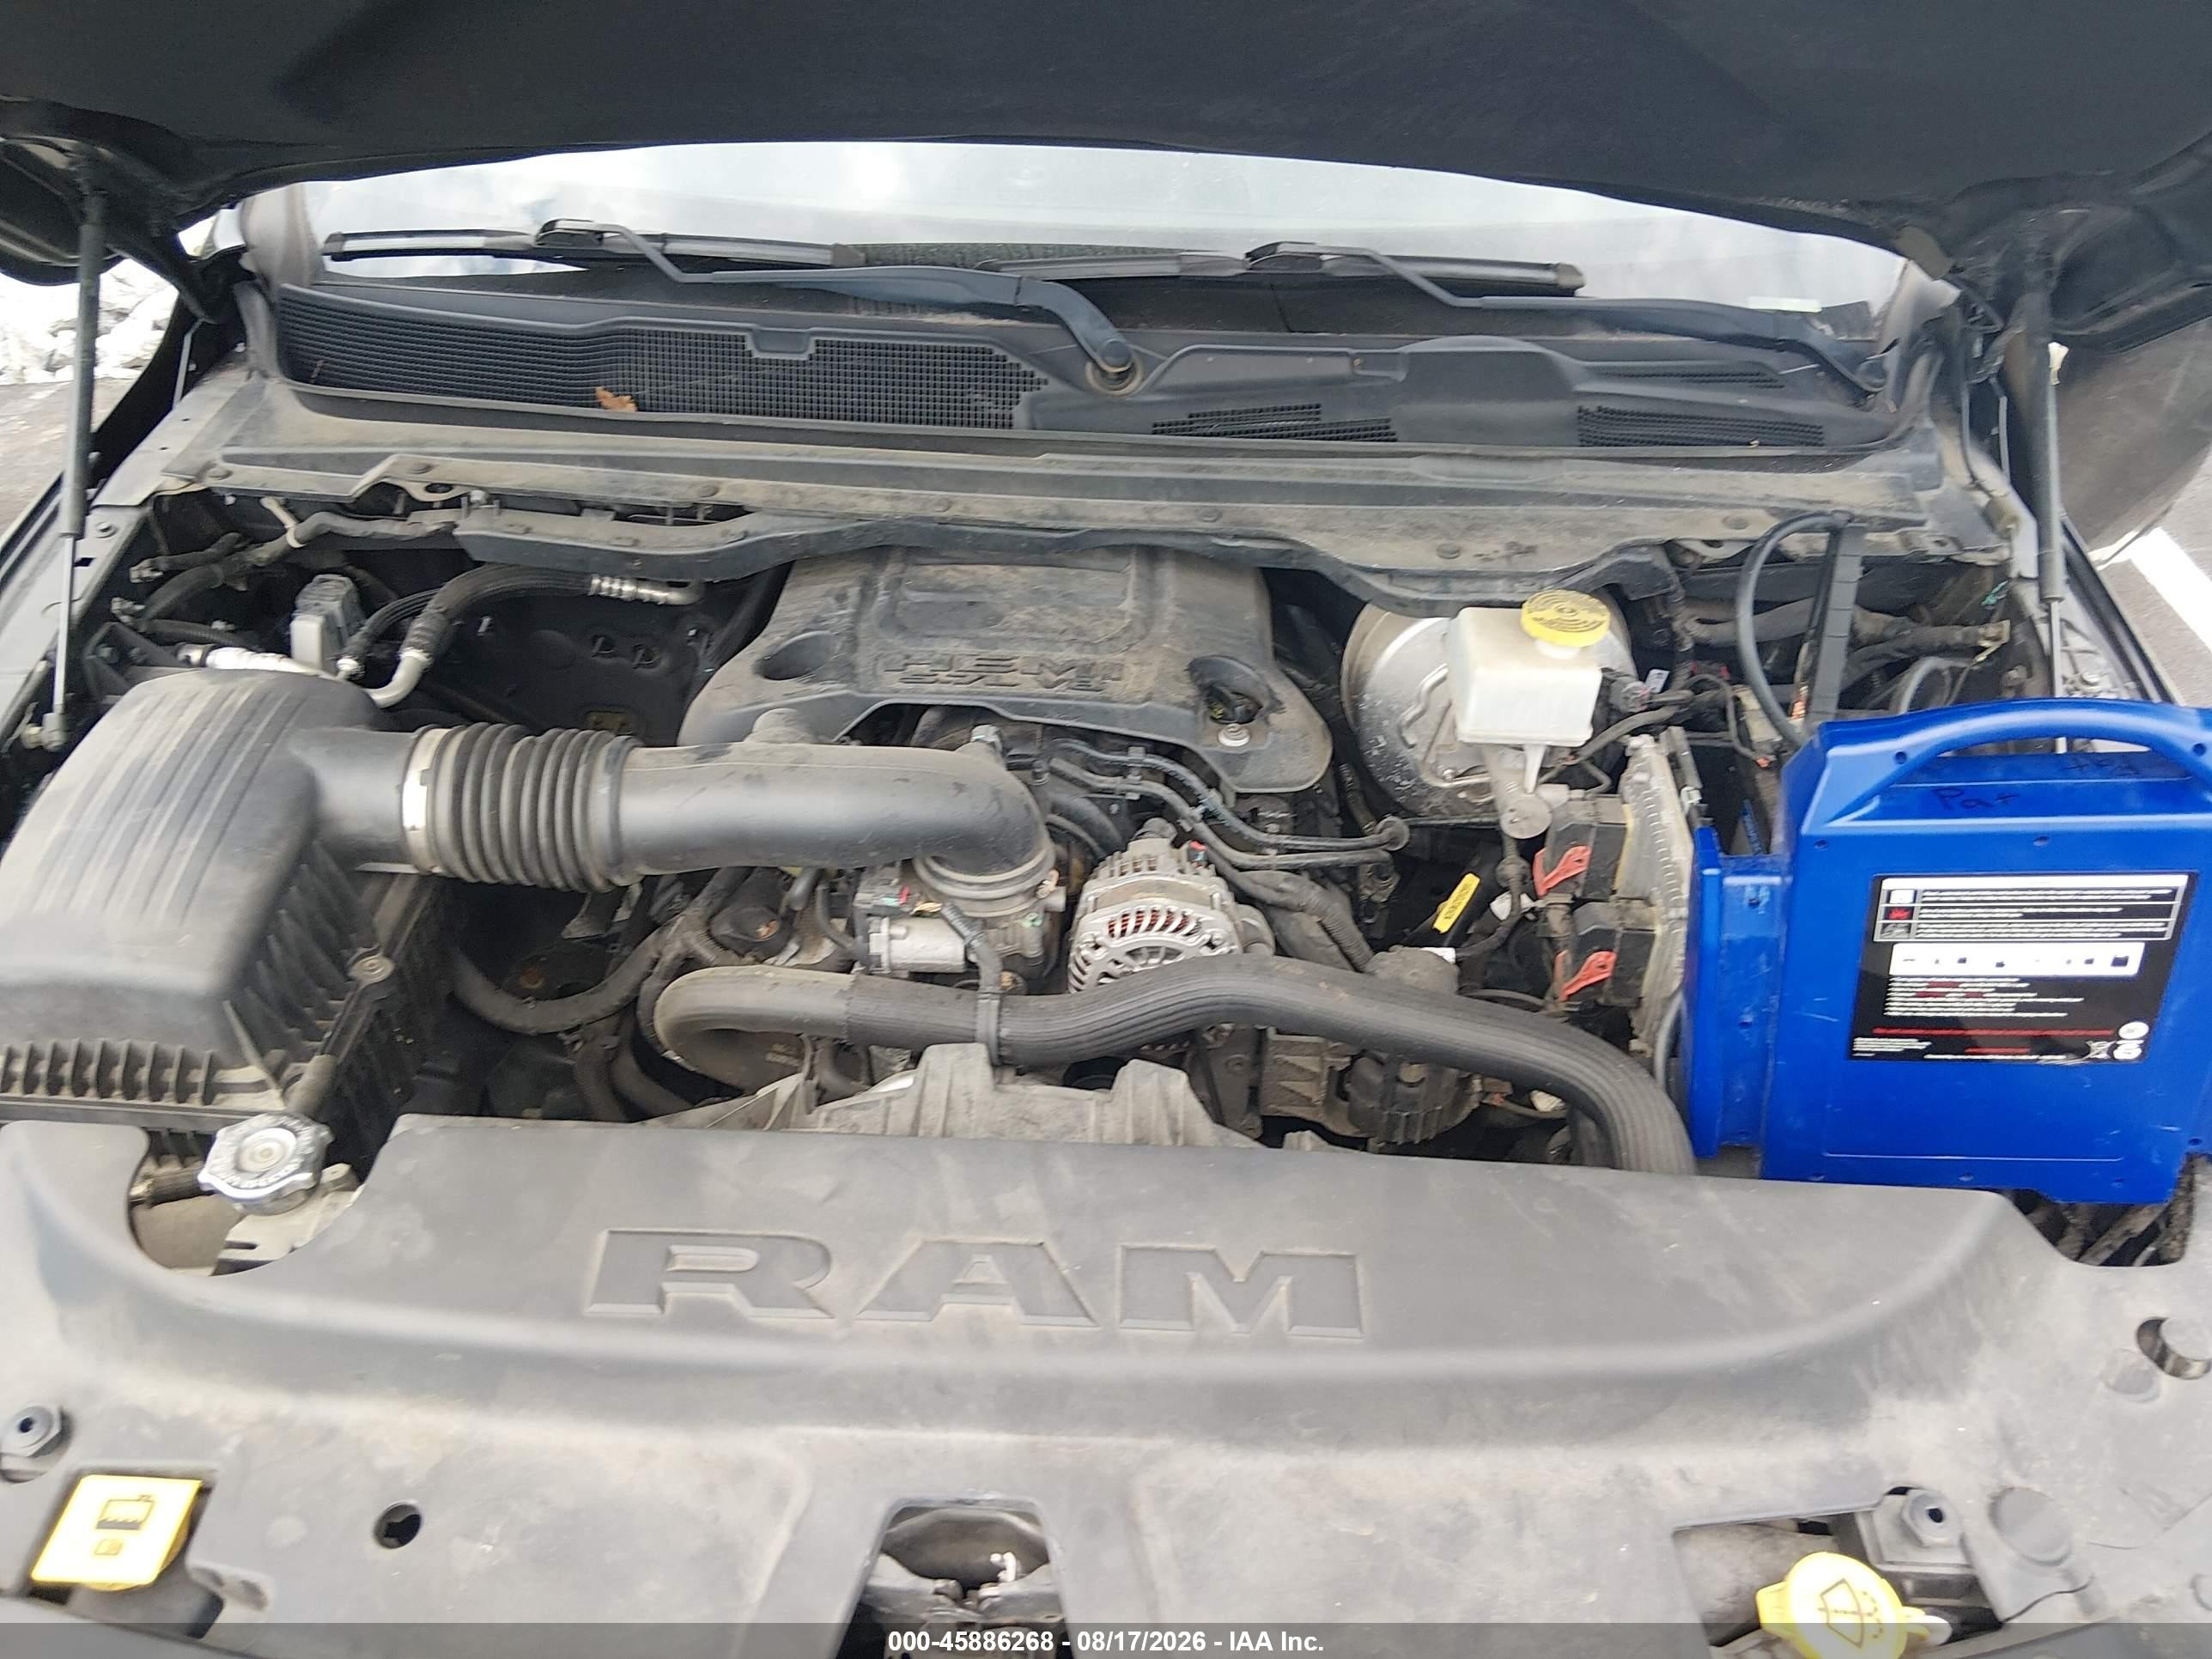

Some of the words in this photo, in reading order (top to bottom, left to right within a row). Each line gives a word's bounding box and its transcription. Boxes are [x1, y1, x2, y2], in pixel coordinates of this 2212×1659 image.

[884, 653, 1125, 681] HEMI
[898, 672, 1021, 688] 5.7L
[586, 1229, 1365, 1339] RAM
